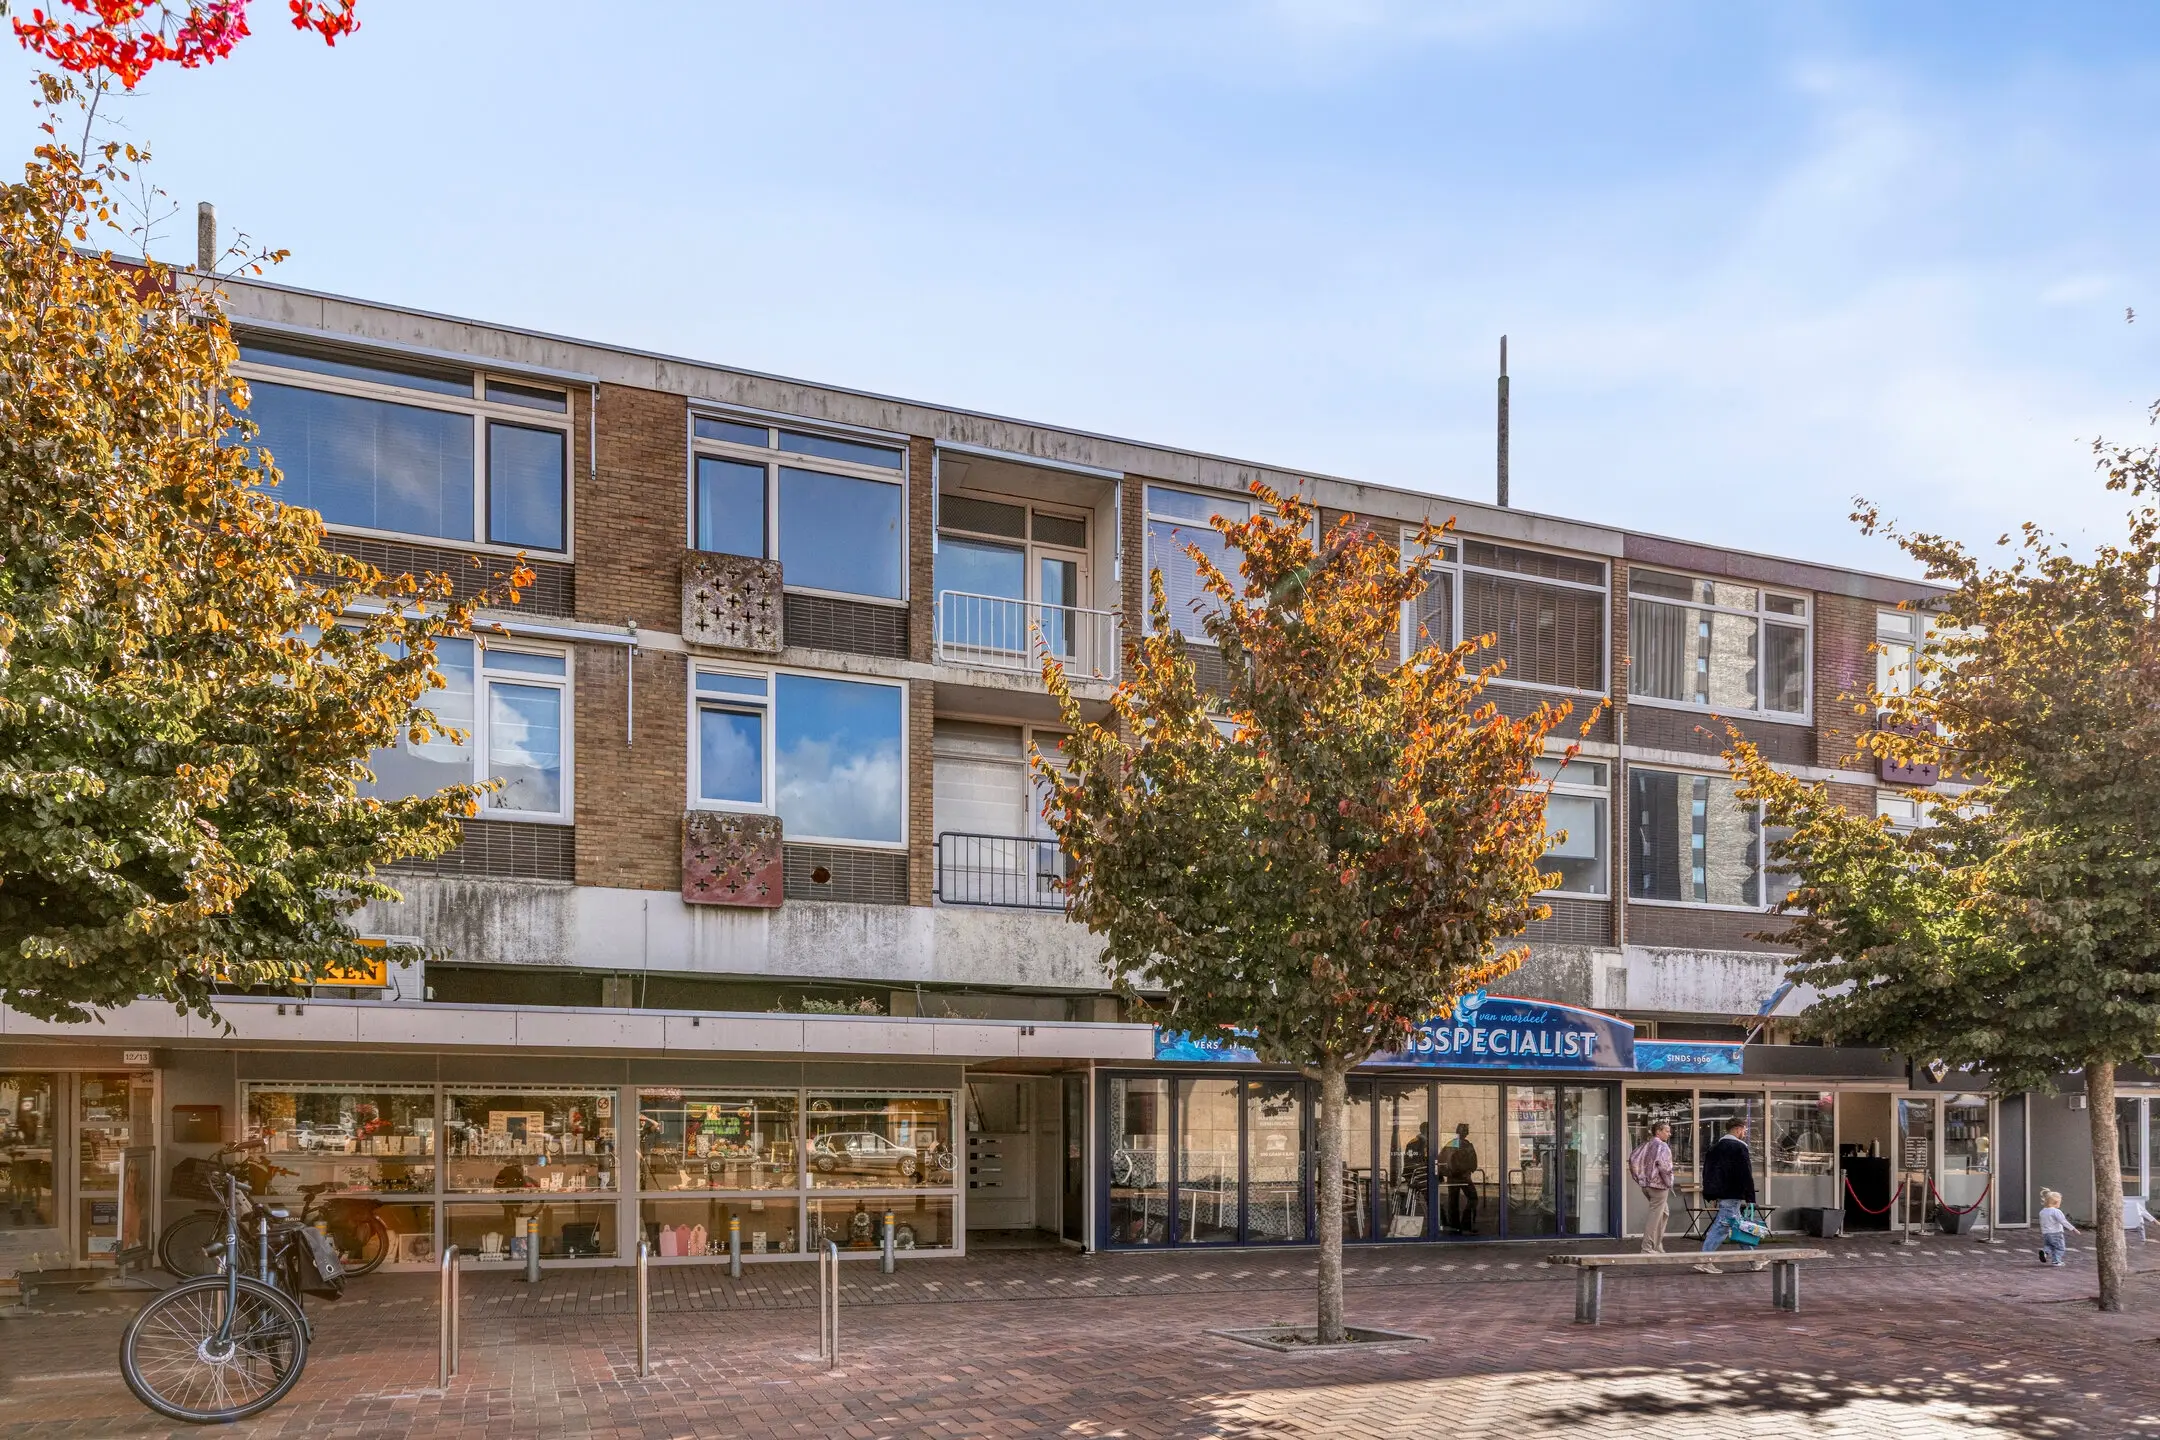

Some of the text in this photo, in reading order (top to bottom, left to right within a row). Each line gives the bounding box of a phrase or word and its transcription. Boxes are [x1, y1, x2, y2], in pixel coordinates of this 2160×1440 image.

[1479, 1010, 1548, 1024] van voordeel
[1193, 1040, 1219, 1050] VERS
[125, 1053, 148, 1061] 12/13
[1666, 1054, 1711, 1064] SINDS 1960
